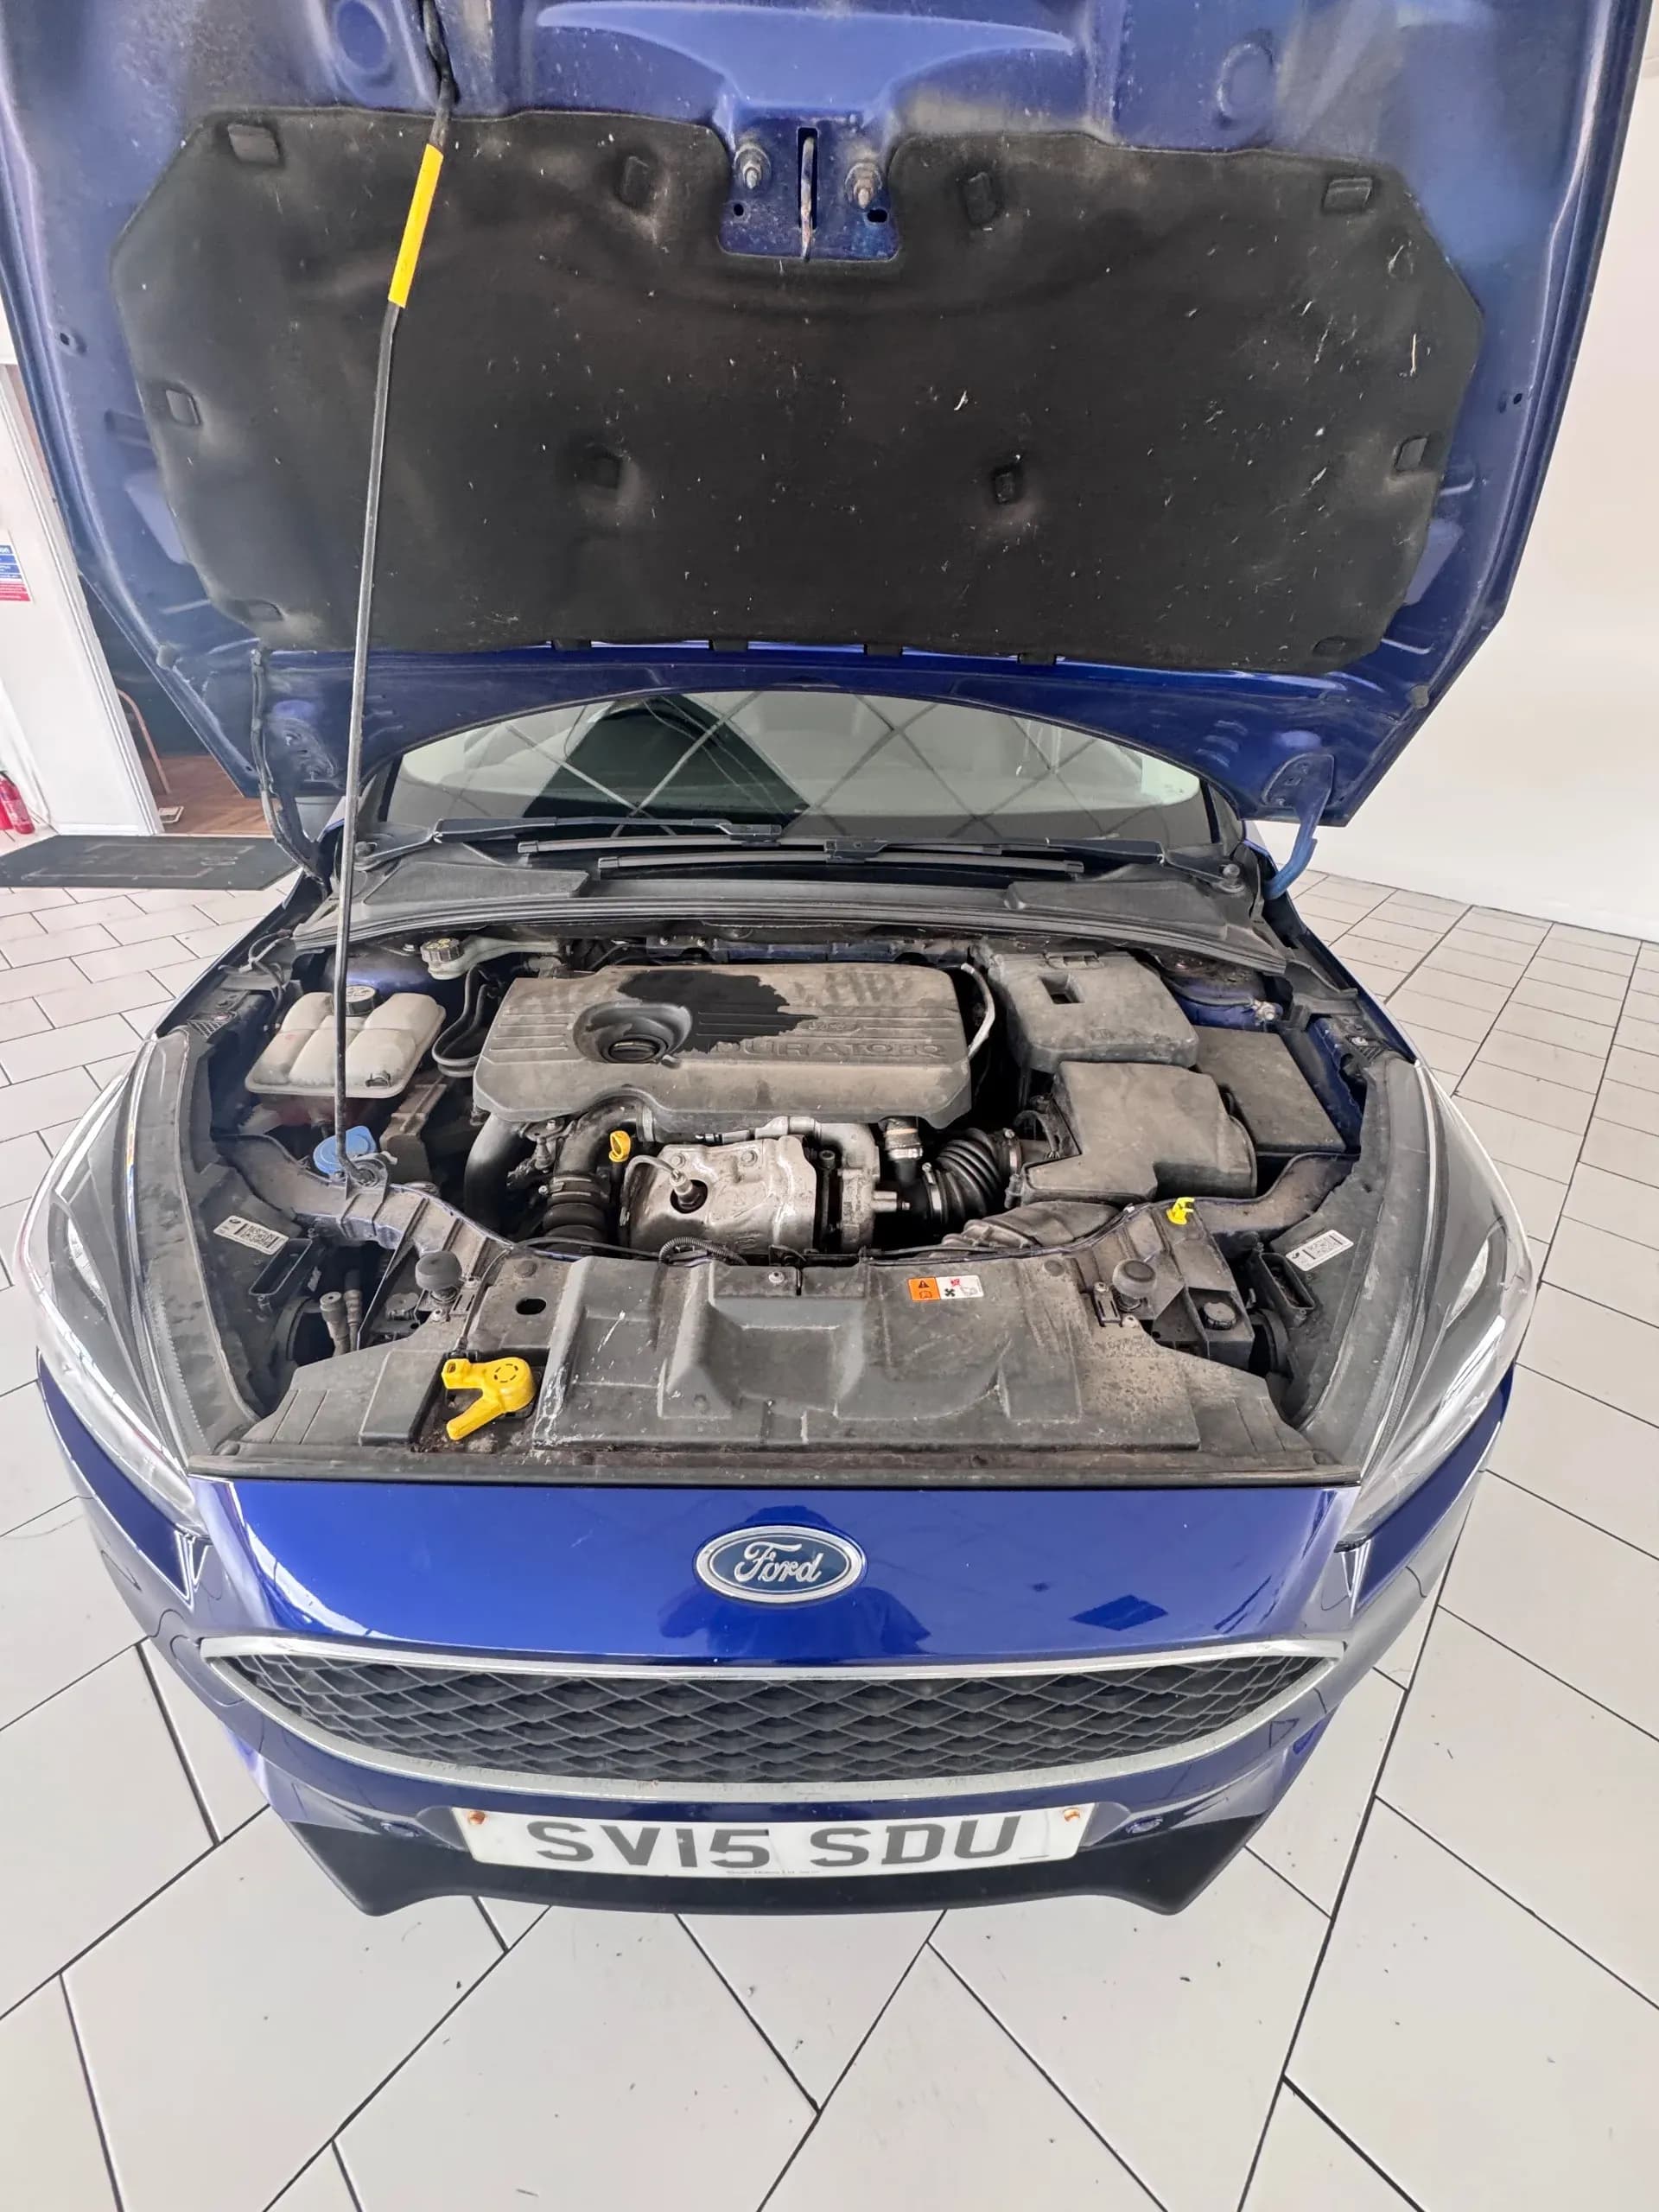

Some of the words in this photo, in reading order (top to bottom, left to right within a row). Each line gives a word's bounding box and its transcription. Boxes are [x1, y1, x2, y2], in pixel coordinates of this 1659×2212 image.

[734, 1541, 824, 1582] Ford
[526, 1820, 771, 1868] SV15
[810, 1815, 1021, 1867] SDU
